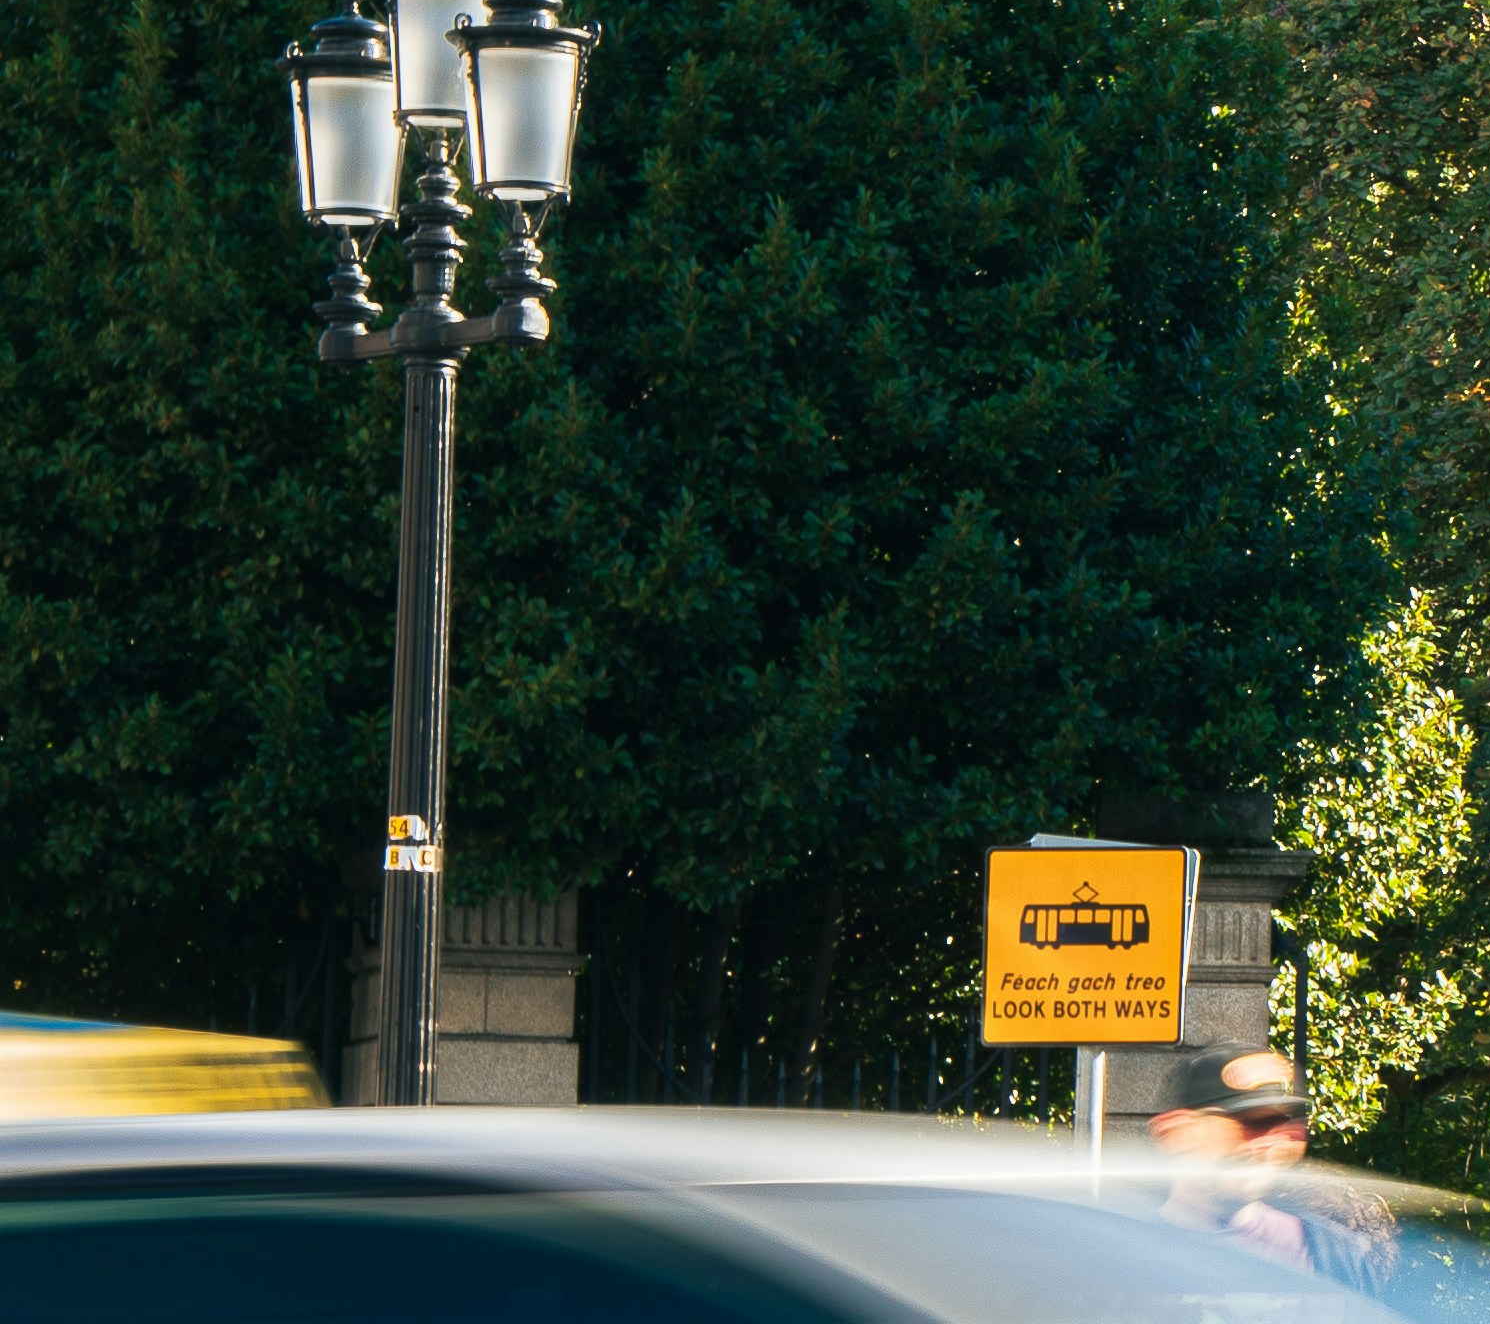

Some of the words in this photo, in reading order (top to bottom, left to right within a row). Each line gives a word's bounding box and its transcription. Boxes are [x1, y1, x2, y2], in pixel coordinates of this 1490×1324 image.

[1067, 972, 1116, 995] gach
[1126, 972, 1166, 991] treo
[992, 1000, 1046, 1019] LOOK
[1053, 1000, 1107, 1019] BOTH
[1114, 1000, 1171, 1019] WAYS
